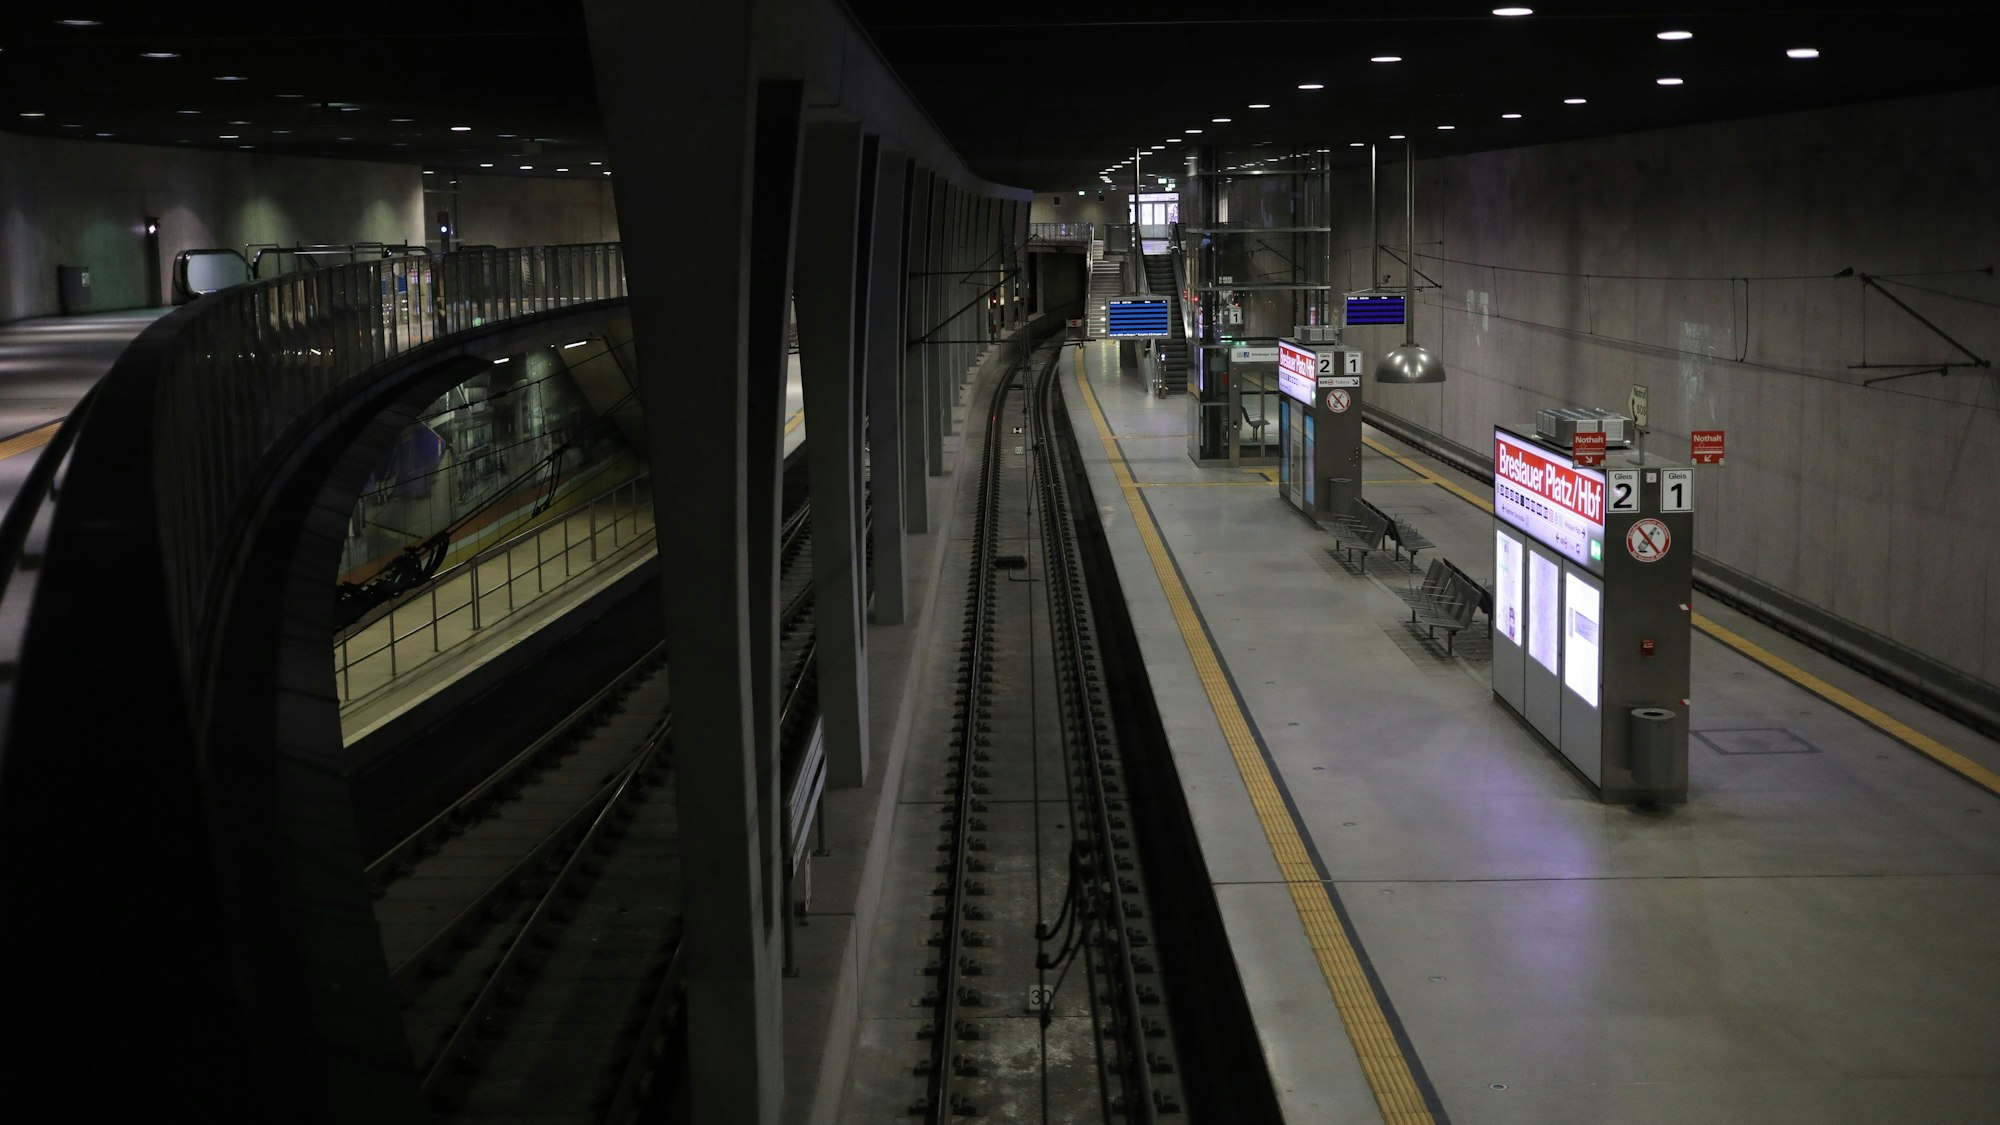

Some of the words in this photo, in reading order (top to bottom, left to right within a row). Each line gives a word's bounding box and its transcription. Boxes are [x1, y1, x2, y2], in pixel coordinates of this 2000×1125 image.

[1320, 359, 1330, 373] 2
[1350, 359, 1357, 373] 1
[1636, 404, 1647, 416] SOS
[1575, 435, 1604, 444] Nothalt
[1693, 434, 1722, 442] Nothalt
[1499, 443, 1544, 493] Breslauer
[1545, 463, 1602, 520] Platz/Hbf
[1668, 472, 1687, 480] Gleis
[1613, 483, 1632, 509] 2
[1671, 483, 1682, 508] 1
[1031, 990, 1052, 1005] 30
